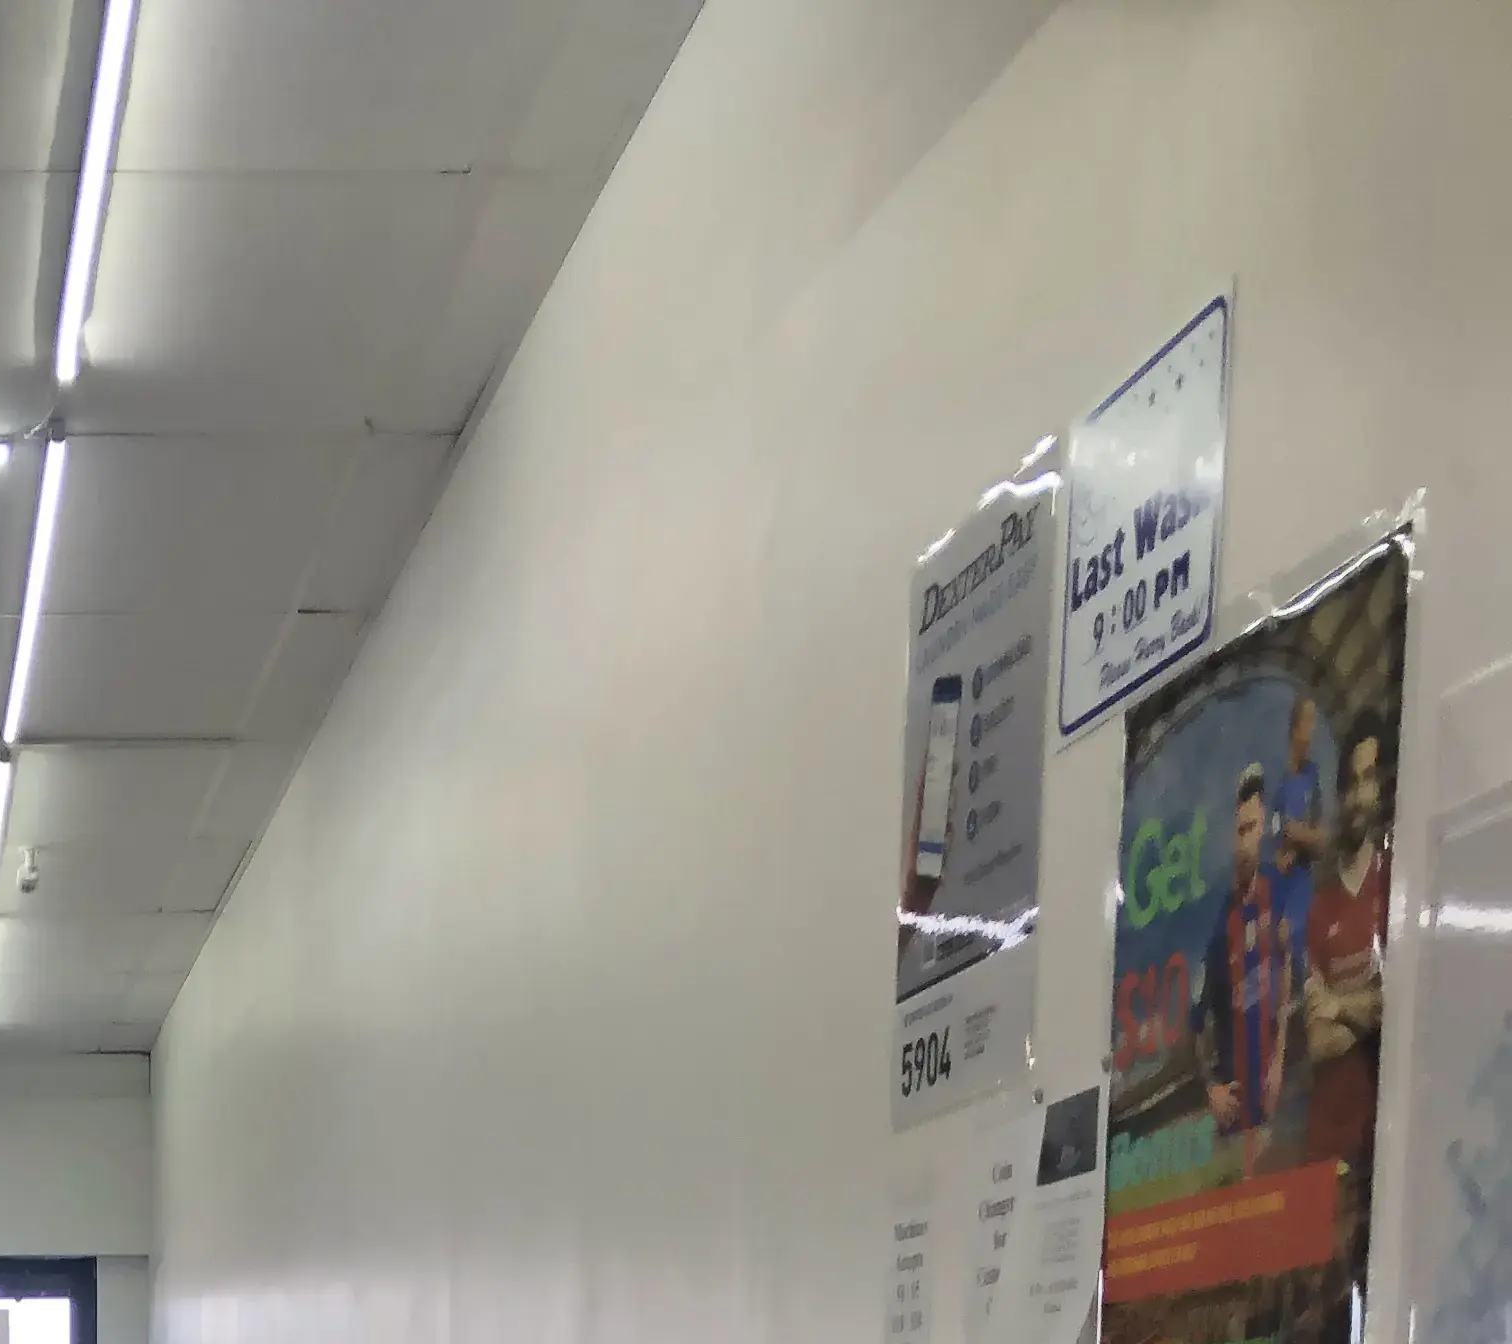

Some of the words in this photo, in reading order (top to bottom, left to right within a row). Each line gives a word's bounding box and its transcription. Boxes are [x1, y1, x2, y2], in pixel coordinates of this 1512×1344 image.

[1071, 526, 1126, 613] Last
[1153, 549, 1190, 611] PM
[1126, 806, 1207, 930] Get
[901, 1025, 952, 1098] 5904
